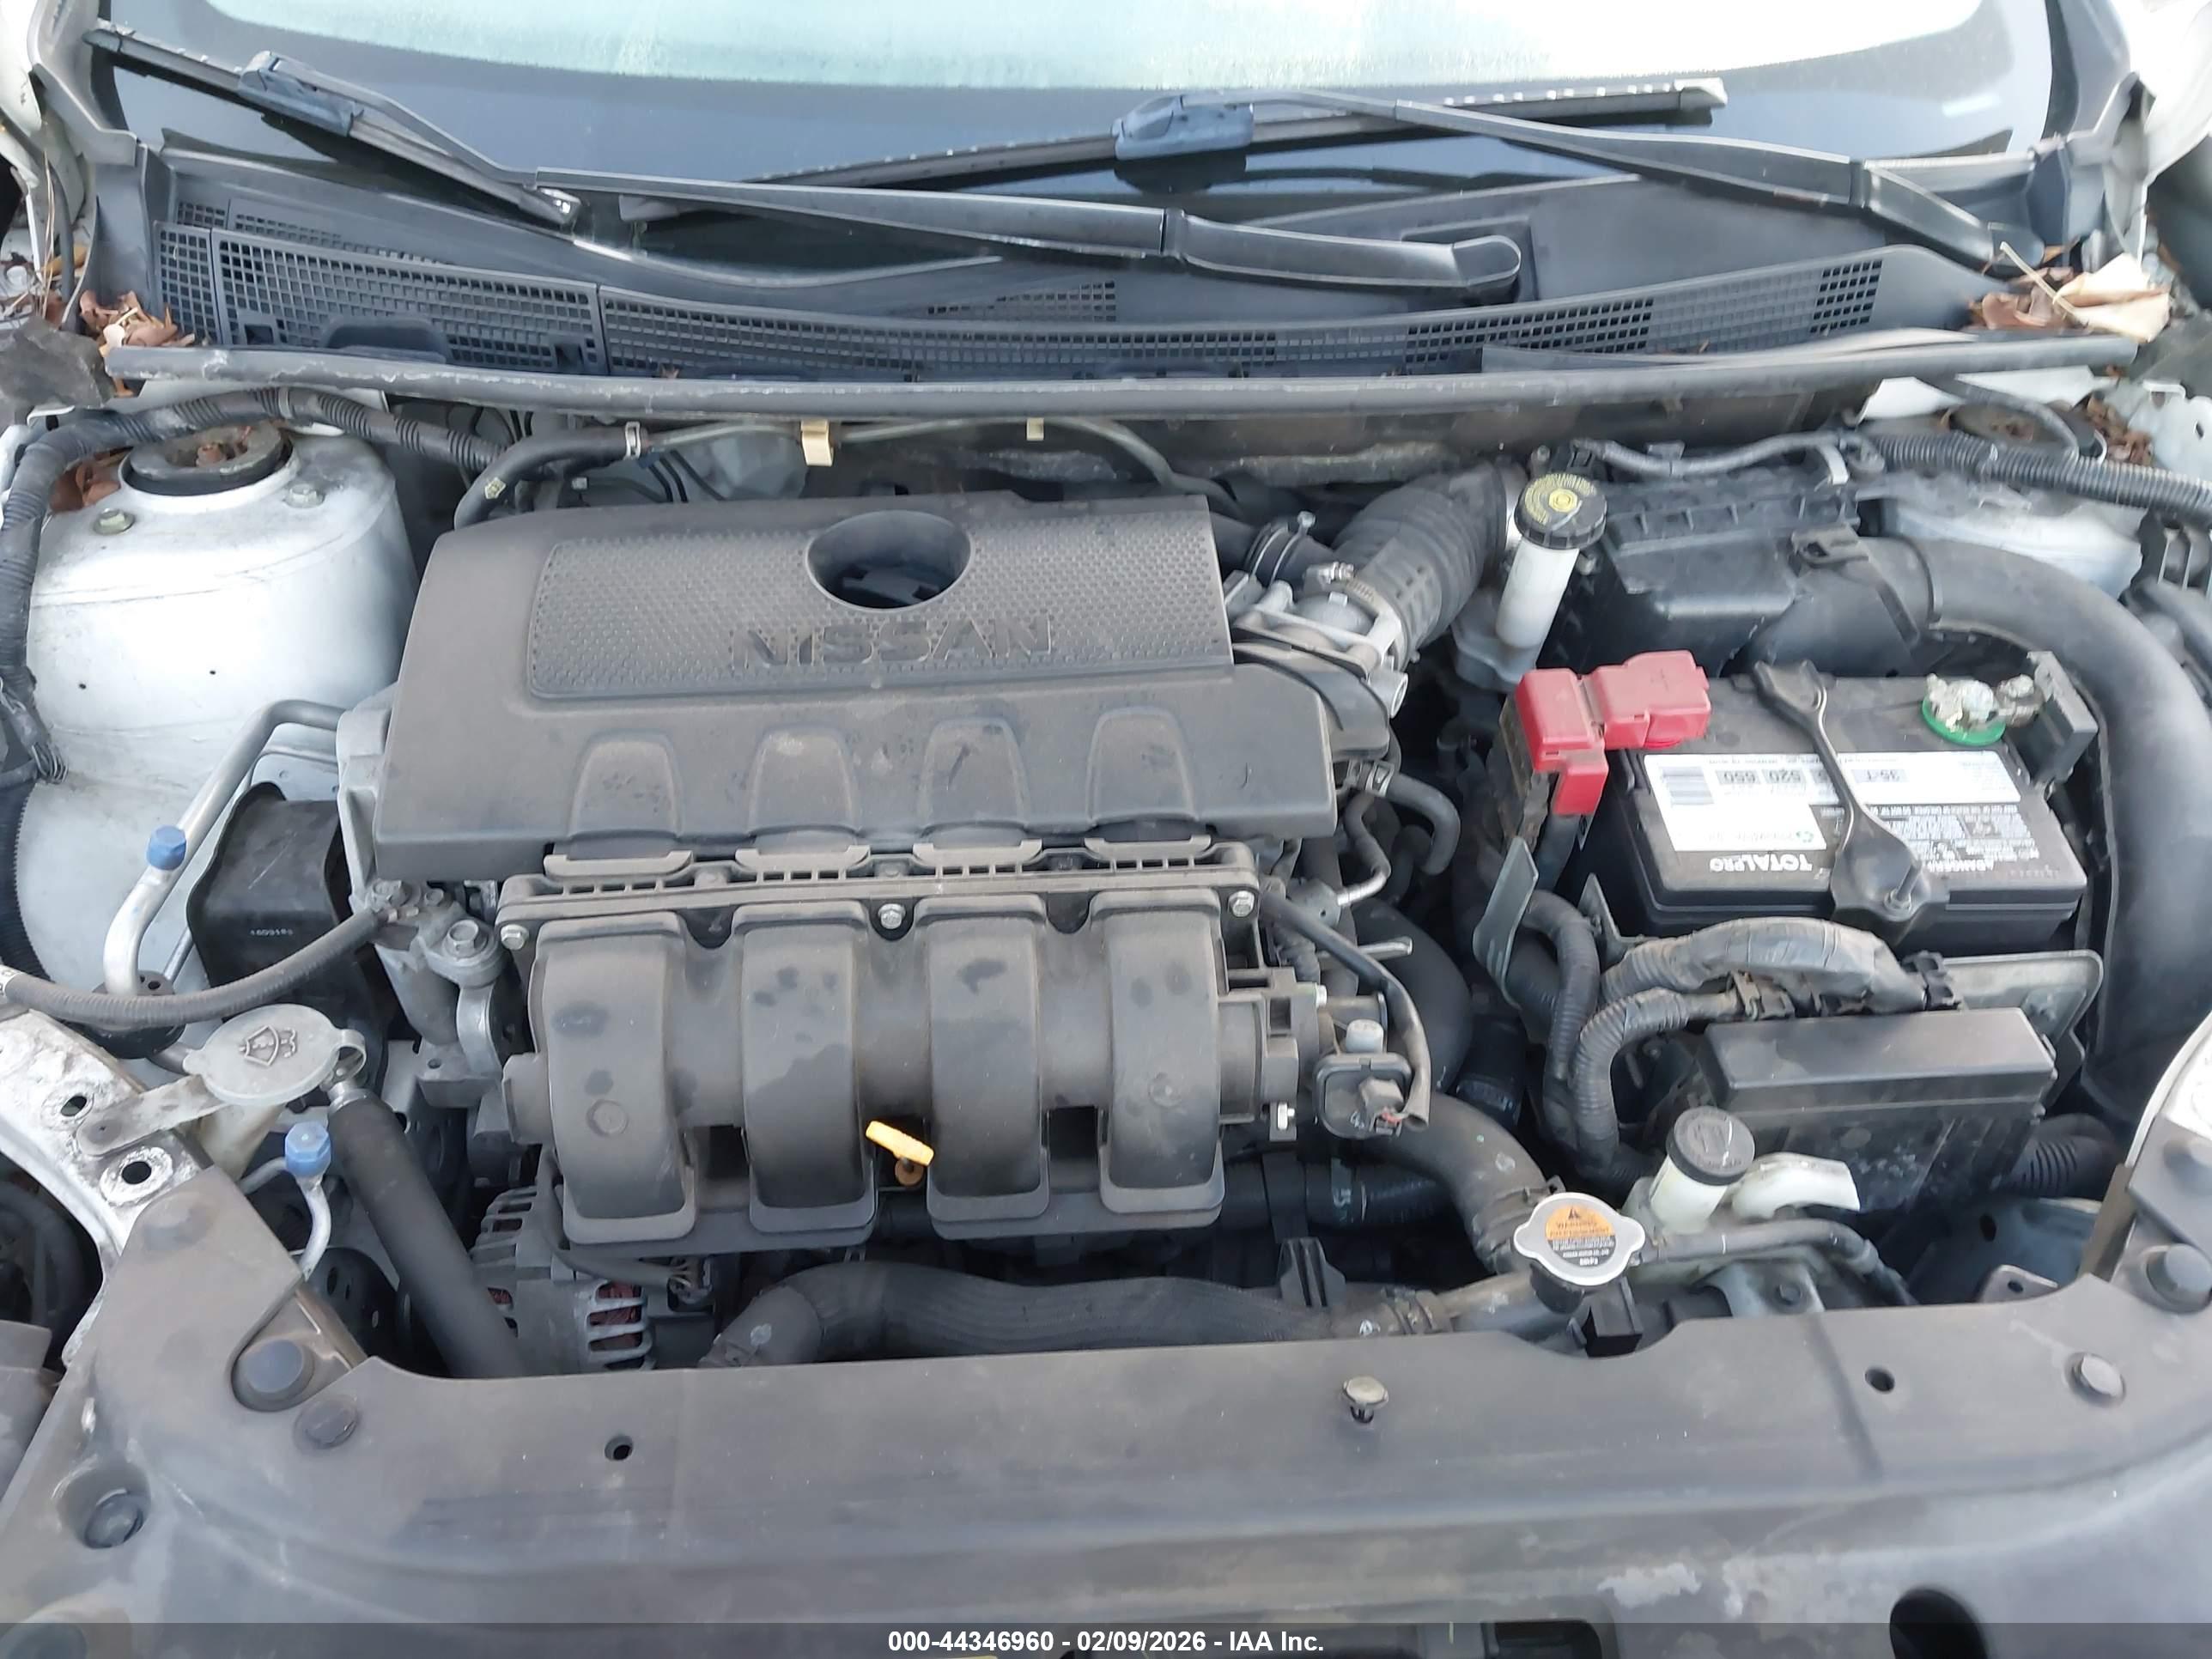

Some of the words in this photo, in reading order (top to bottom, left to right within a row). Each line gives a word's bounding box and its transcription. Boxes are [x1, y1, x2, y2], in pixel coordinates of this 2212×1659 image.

[732, 615, 1052, 667] NISSAN
[1723, 770, 1758, 784] 650
[1767, 769, 1802, 784] 520
[1709, 854, 1814, 872] TOTALPRO
